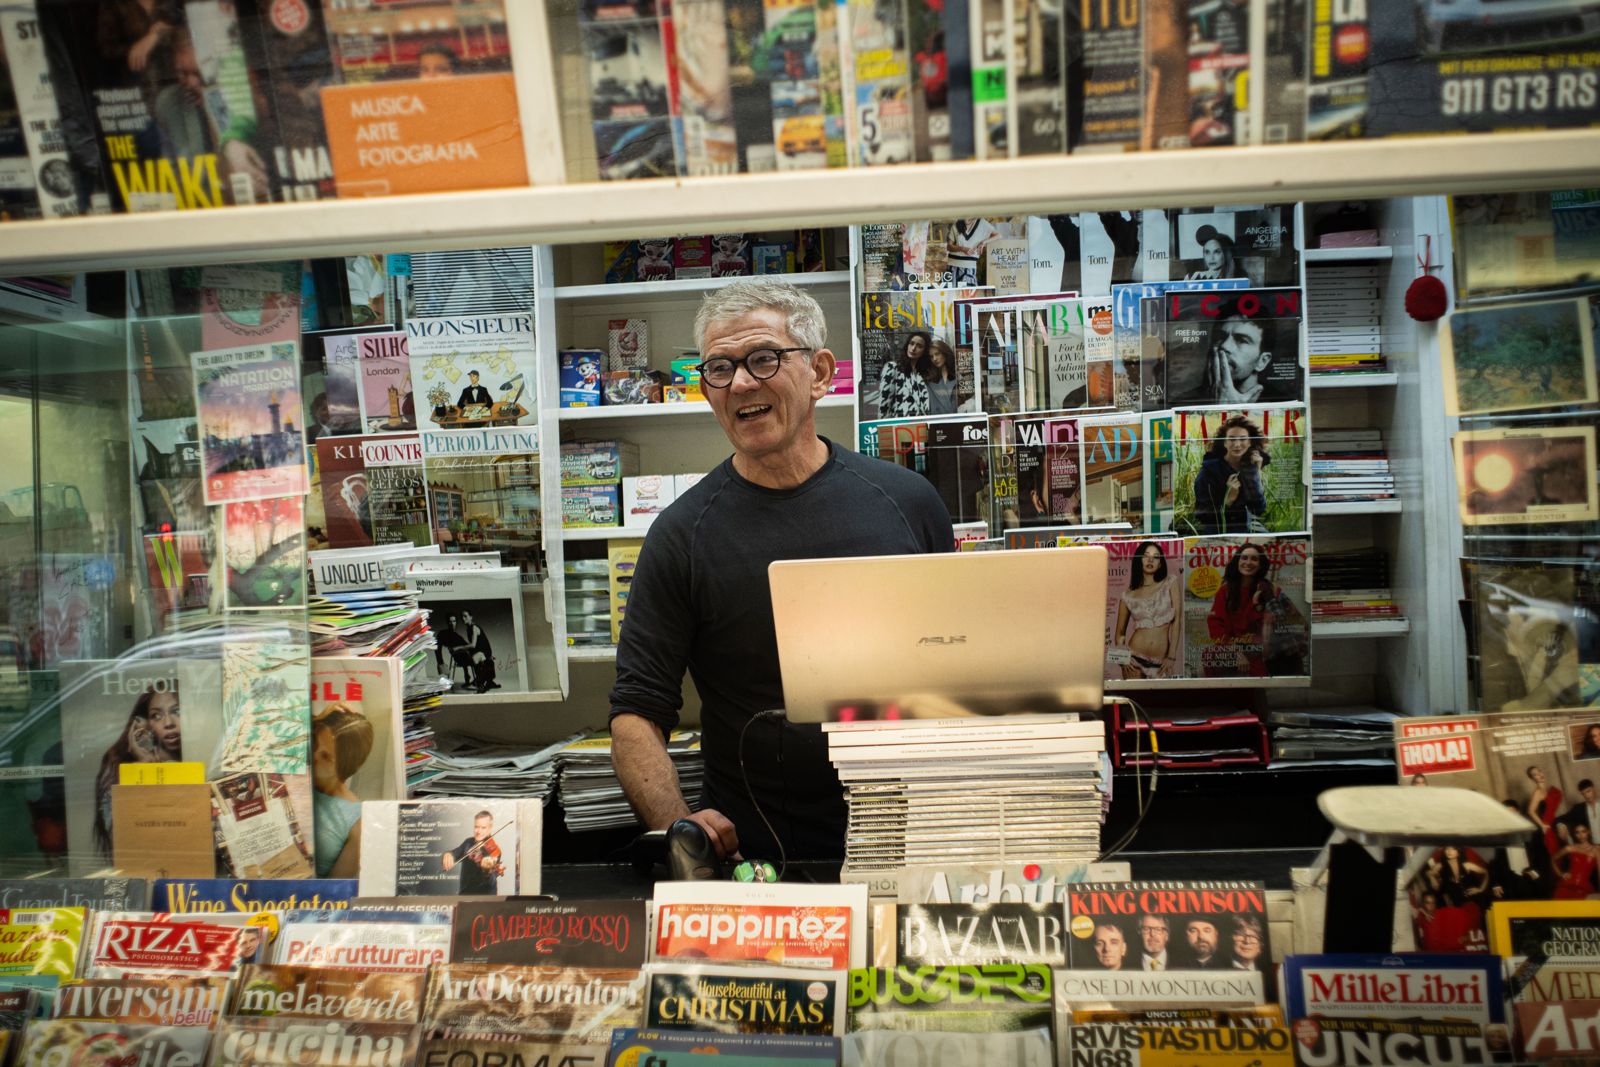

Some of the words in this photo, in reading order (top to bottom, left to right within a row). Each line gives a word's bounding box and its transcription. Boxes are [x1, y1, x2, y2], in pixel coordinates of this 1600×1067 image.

[1441, 78, 1484, 115] 911
[1492, 74, 1549, 112] GT3
[1557, 71, 1598, 108] RS
[351, 96, 425, 118] MUSICA
[356, 122, 399, 143] ARTE
[105, 135, 137, 160] THE
[358, 143, 478, 167] FOTOGRAFIA
[1245, 226, 1287, 234] ANGELINA
[1255, 234, 1278, 242] JOLIE
[1032, 258, 1053, 269] Tom.
[1088, 254, 1109, 265] Tom.
[1147, 250, 1168, 260] Tom.
[908, 273, 931, 282] OUR
[934, 272, 953, 281] BIG
[1172, 291, 1299, 320] ICON
[408, 317, 533, 337] MONSIEUR
[1175, 329, 1190, 337] FREE
[1191, 328, 1207, 337] from
[1058, 343, 1073, 352] For
[1183, 336, 1200, 344] FEAR
[197, 357, 209, 366] THE
[211, 354, 233, 364] ABILITY
[235, 352, 243, 361] TO
[244, 350, 265, 360] DREAM
[1054, 353, 1080, 363] LOVE
[220, 366, 293, 387] NATATION
[366, 367, 400, 377] London
[243, 380, 295, 393] MARATHON
[423, 432, 480, 453] PERIOD
[481, 430, 538, 451] LIVING
[1087, 427, 1138, 464] AD
[1053, 444, 1069, 459] 12
[368, 469, 397, 479] TIME
[399, 468, 417, 478] TO
[370, 479, 393, 489] GET
[1188, 537, 1307, 570] avages
[416, 579, 453, 588] WhitePaper
[917, 635, 967, 646] ASUS
[1404, 739, 1470, 766] ¡HOLA!
[1076, 883, 1118, 892] UNCUT
[1125, 881, 1184, 891] CURATED
[1192, 880, 1256, 890] EDITIONS
[166, 883, 226, 913] Wine
[231, 883, 349, 912] Spectator
[1071, 891, 1137, 916] KING
[1140, 889, 1265, 915] CRIMSON
[471, 914, 564, 952] GAMBERO
[567, 914, 630, 953] ROSSO
[661, 907, 847, 945] happinez
[96, 925, 202, 961] RIZA
[904, 915, 1063, 958] BAZAAR
[132, 954, 200, 962] PSICOSOMATICA
[287, 941, 445, 966] Ristrutturare
[698, 980, 773, 999] HouseBeautiful
[774, 990, 787, 999] at
[1063, 978, 1108, 997] CASE
[1114, 979, 1135, 996] DI
[1140, 979, 1256, 997] MONTAGNA
[1308, 972, 1483, 1004] MilleLibri
[241, 983, 413, 1022] melaverde
[658, 997, 824, 1024] CHRISTMAS
[173, 1009, 214, 1026] belli
[223, 1022, 405, 1067] cucina
[638, 1032, 659, 1040] FLOW
[1070, 1027, 1289, 1051] RIVISTASTUDIO
[1297, 1029, 1488, 1067] UNCUT
[1072, 1050, 1132, 1067] N68
